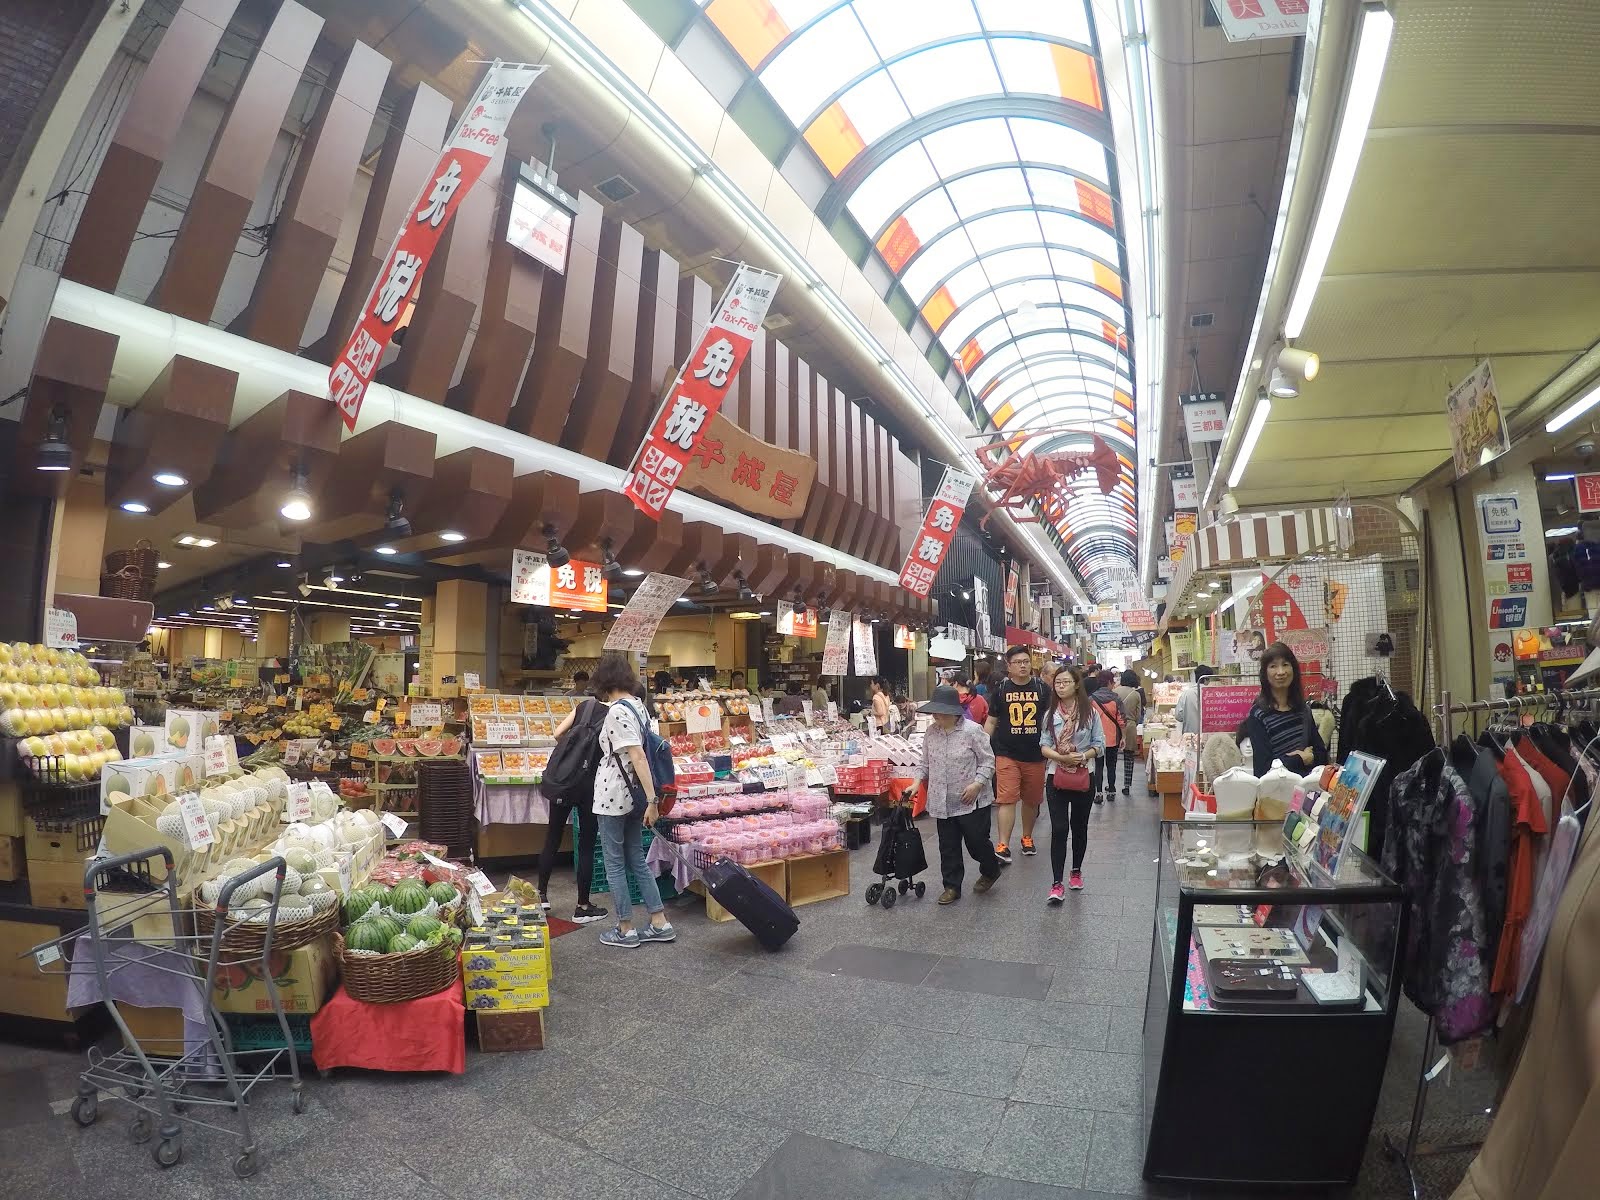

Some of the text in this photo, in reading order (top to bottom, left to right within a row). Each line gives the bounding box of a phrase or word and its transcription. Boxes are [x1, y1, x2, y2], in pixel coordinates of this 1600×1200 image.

[1257, 19, 1300, 31] Daiki
[459, 123, 500, 147] Tax-Free
[373, 159, 462, 323] 免税
[721, 309, 759, 333] Tax-Free
[663, 336, 736, 451] 免税
[1192, 419, 1225, 433] 三都屋
[693, 438, 799, 506] 千成屋
[941, 490, 966, 504] Tax-Free
[1491, 506, 1510, 517] 免税
[917, 505, 956, 564] 免税
[516, 575, 547, 587] Tax-Free
[556, 563, 603, 594] 免税
[1509, 583, 1533, 592] SECOM
[1492, 604, 1526, 615] UnionPay
[61, 633, 76, 642] 498
[1005, 691, 1040, 703] OSAKA
[1008, 702, 1037, 727] 02
[1010, 727, 1024, 735] EST.
[499, 954, 520, 962] ROYAL
